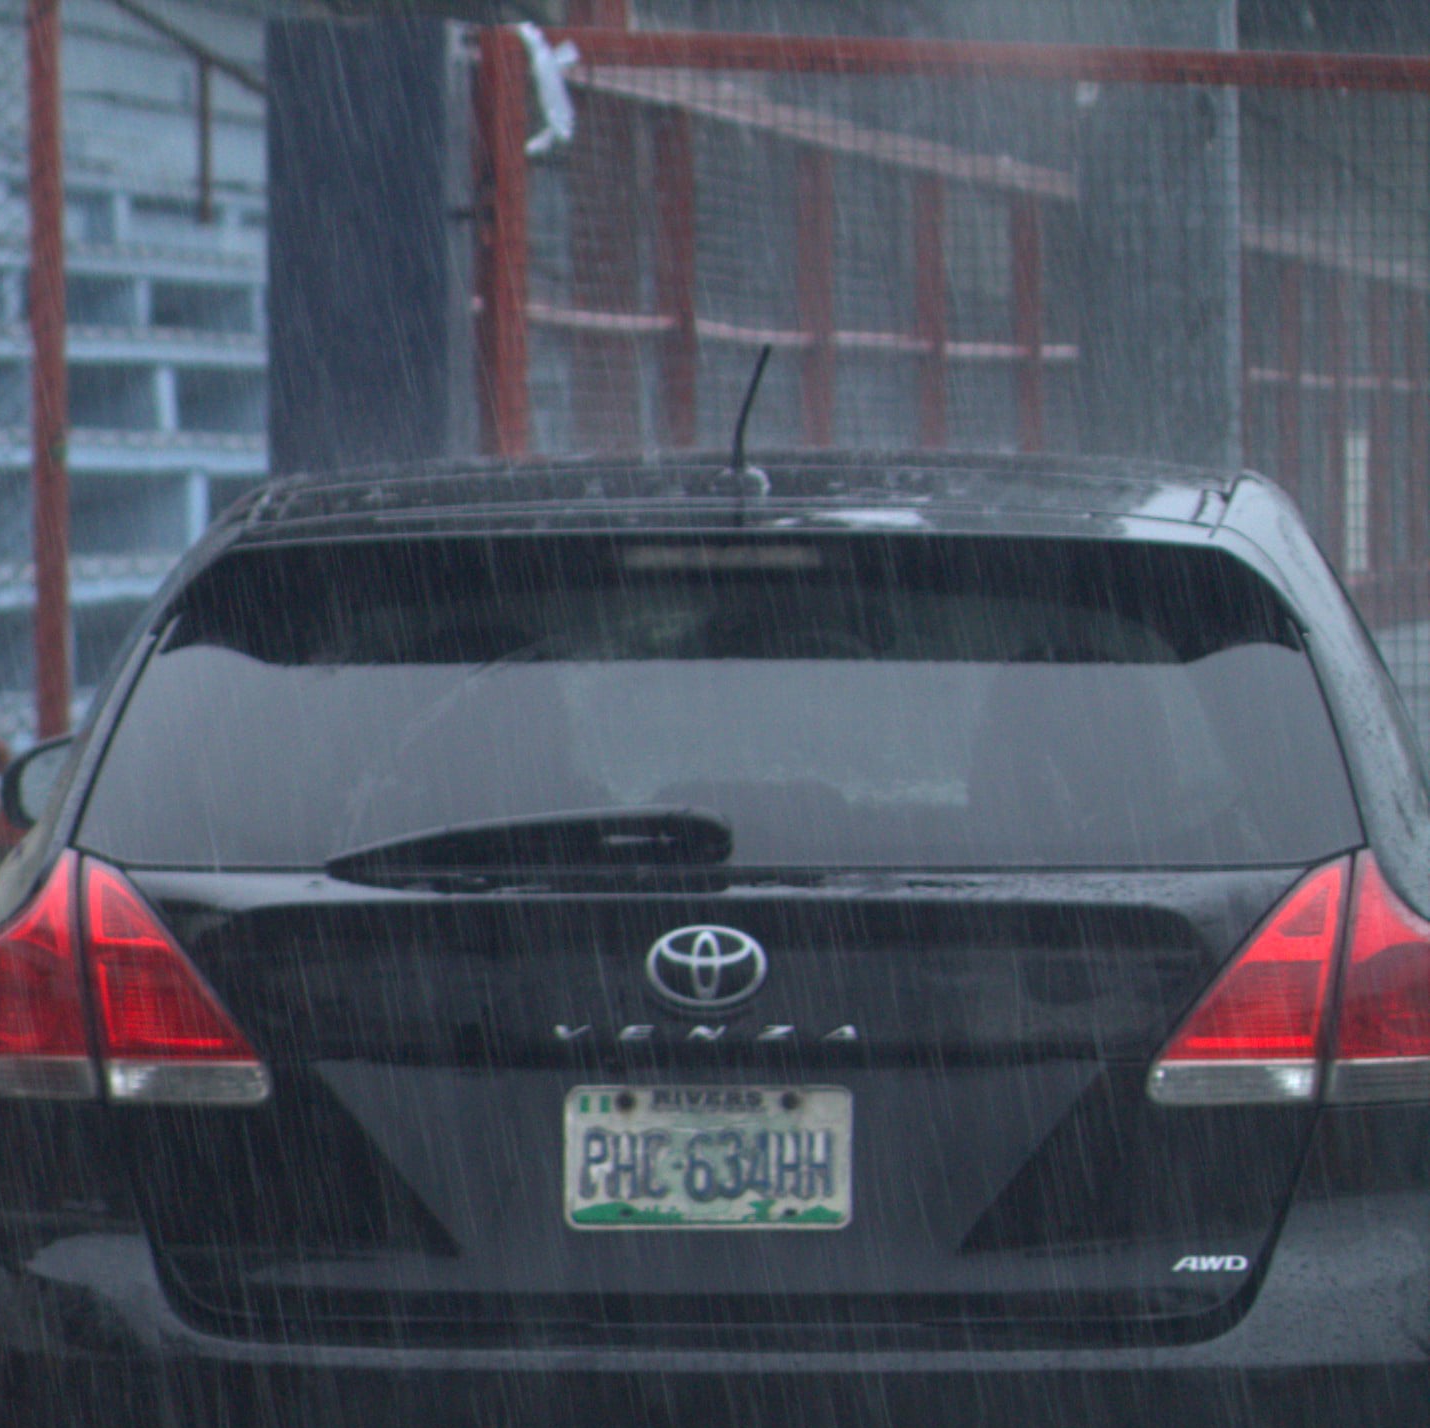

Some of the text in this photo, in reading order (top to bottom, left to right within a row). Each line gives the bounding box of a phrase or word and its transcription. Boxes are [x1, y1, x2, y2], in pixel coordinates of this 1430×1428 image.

[554, 1024, 858, 1041] VENZA
[652, 1089, 765, 1107] RIVERS
[1172, 1255, 1248, 1272] AWD
